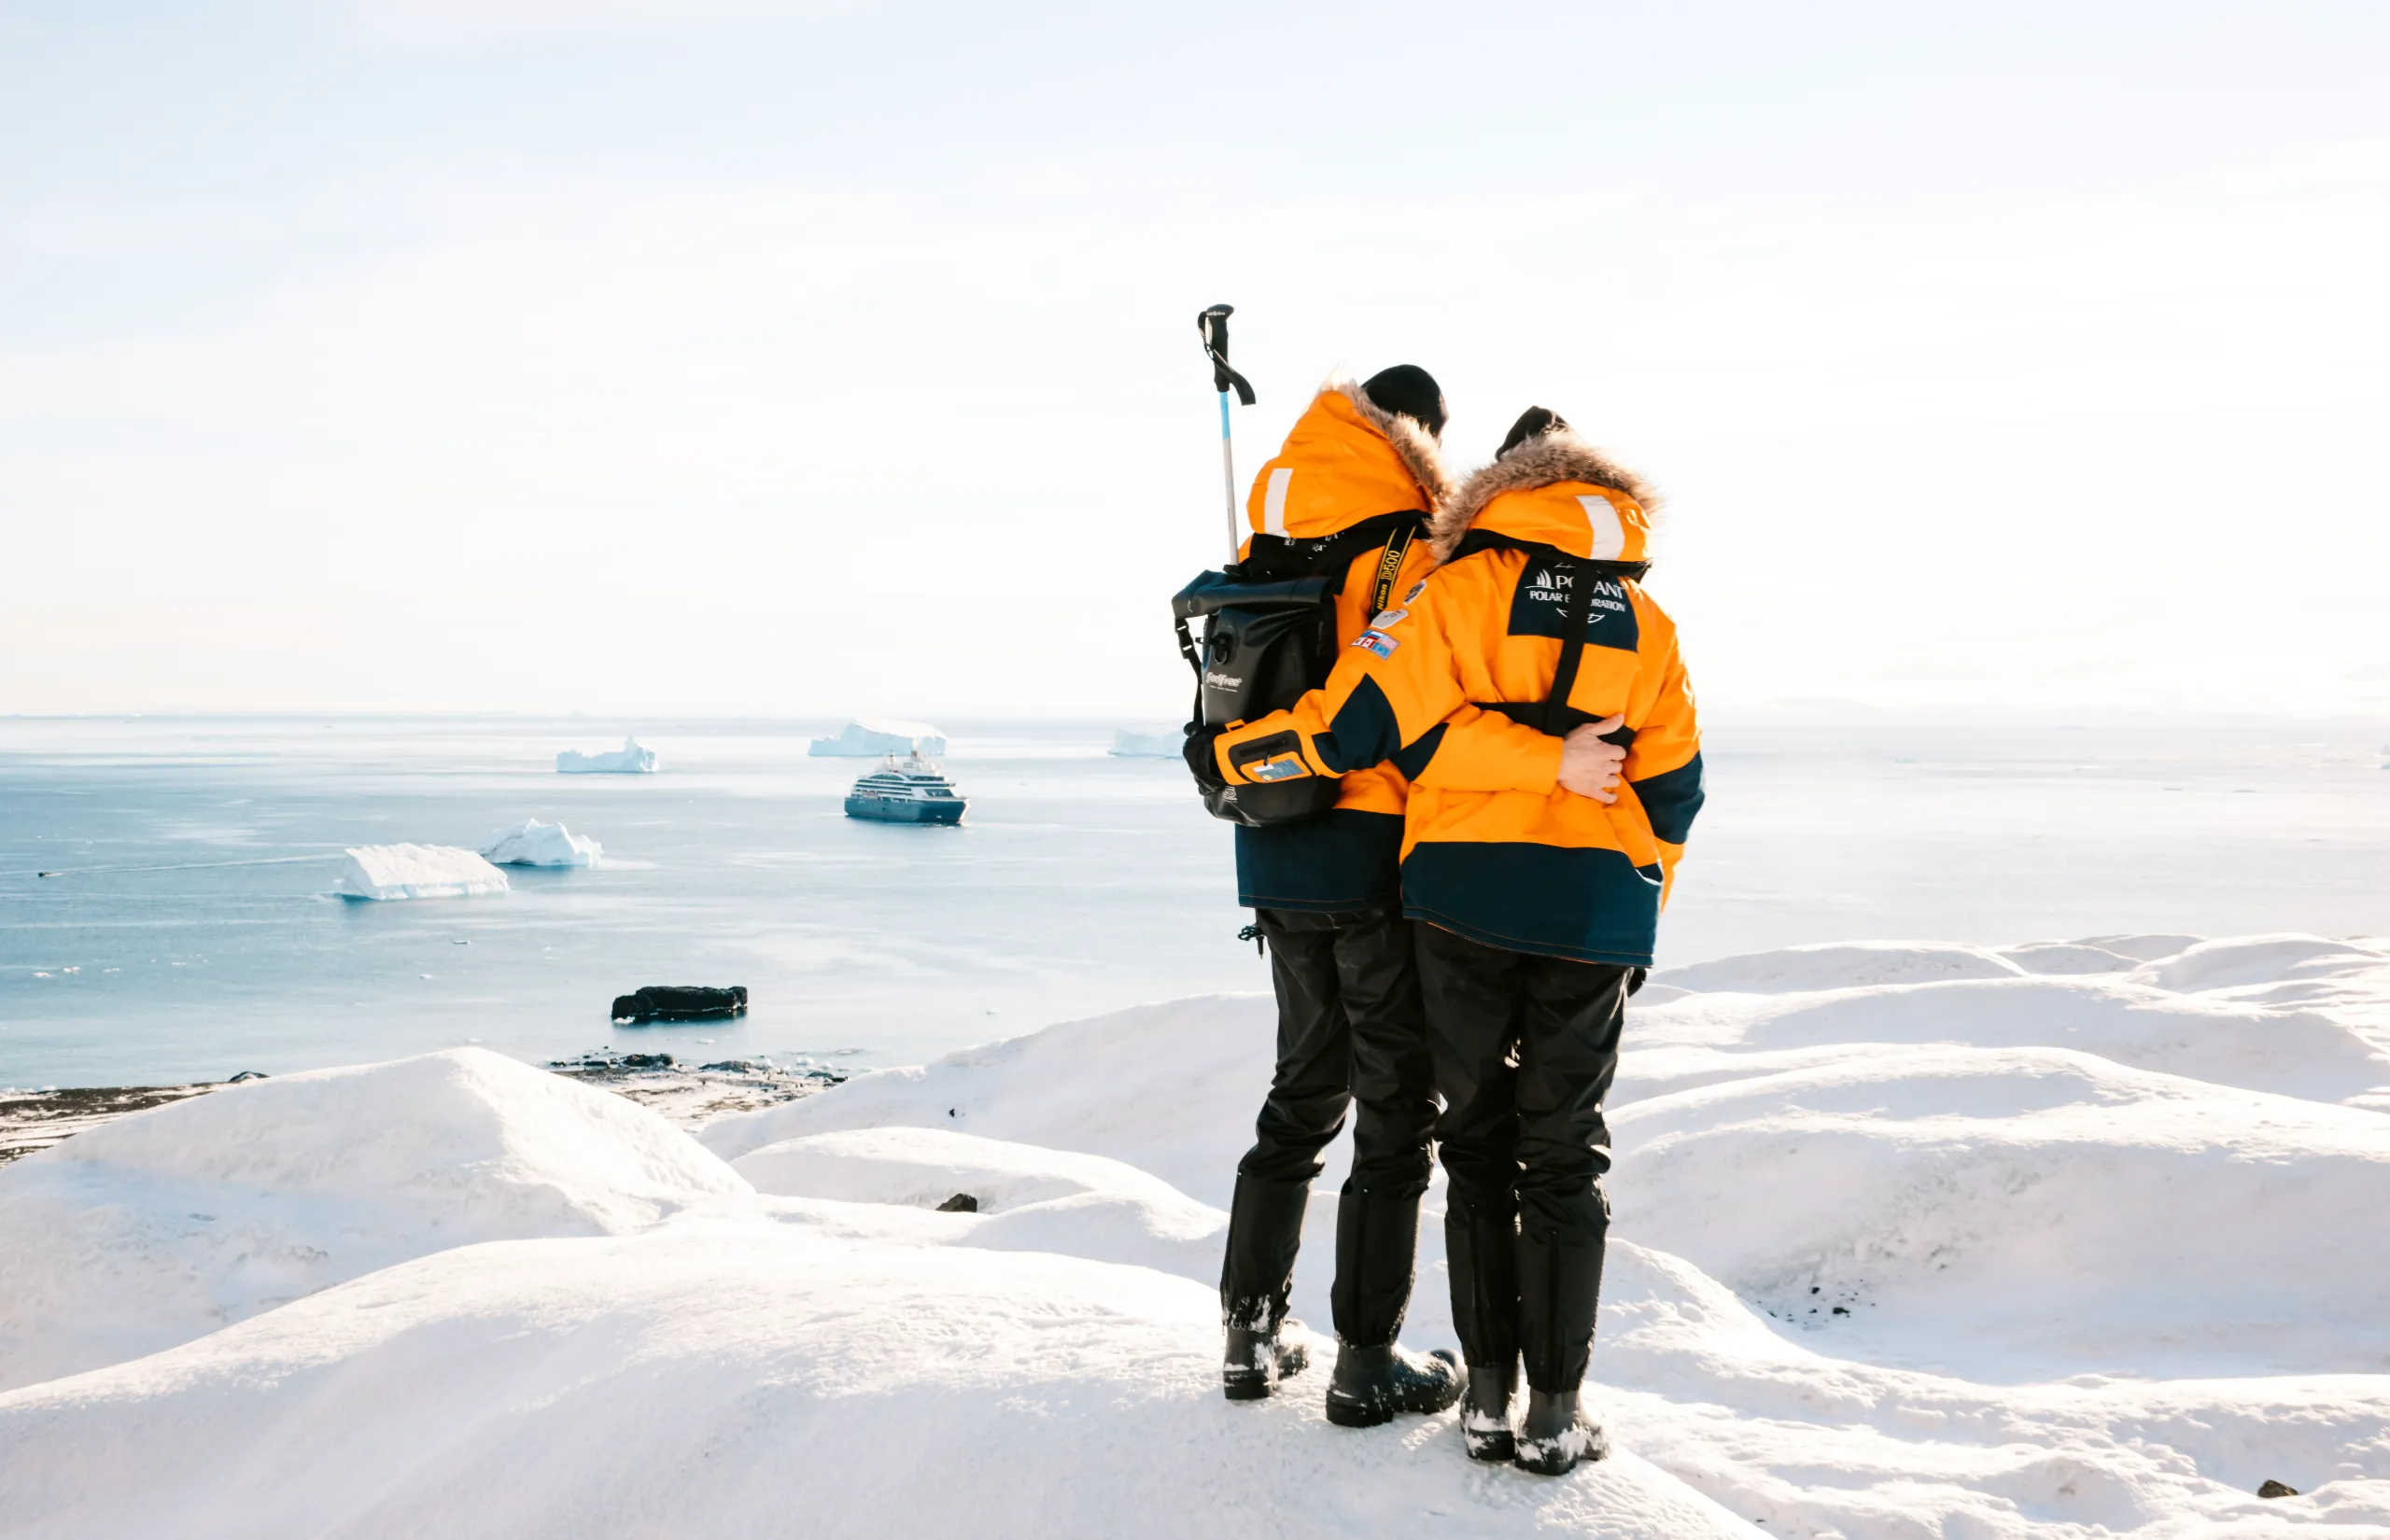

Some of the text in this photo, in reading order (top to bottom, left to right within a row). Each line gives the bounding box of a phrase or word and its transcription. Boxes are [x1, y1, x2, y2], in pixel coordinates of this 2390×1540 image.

[1376, 550, 1401, 609] Nikon D500
[1529, 590, 1563, 602] POLAR
